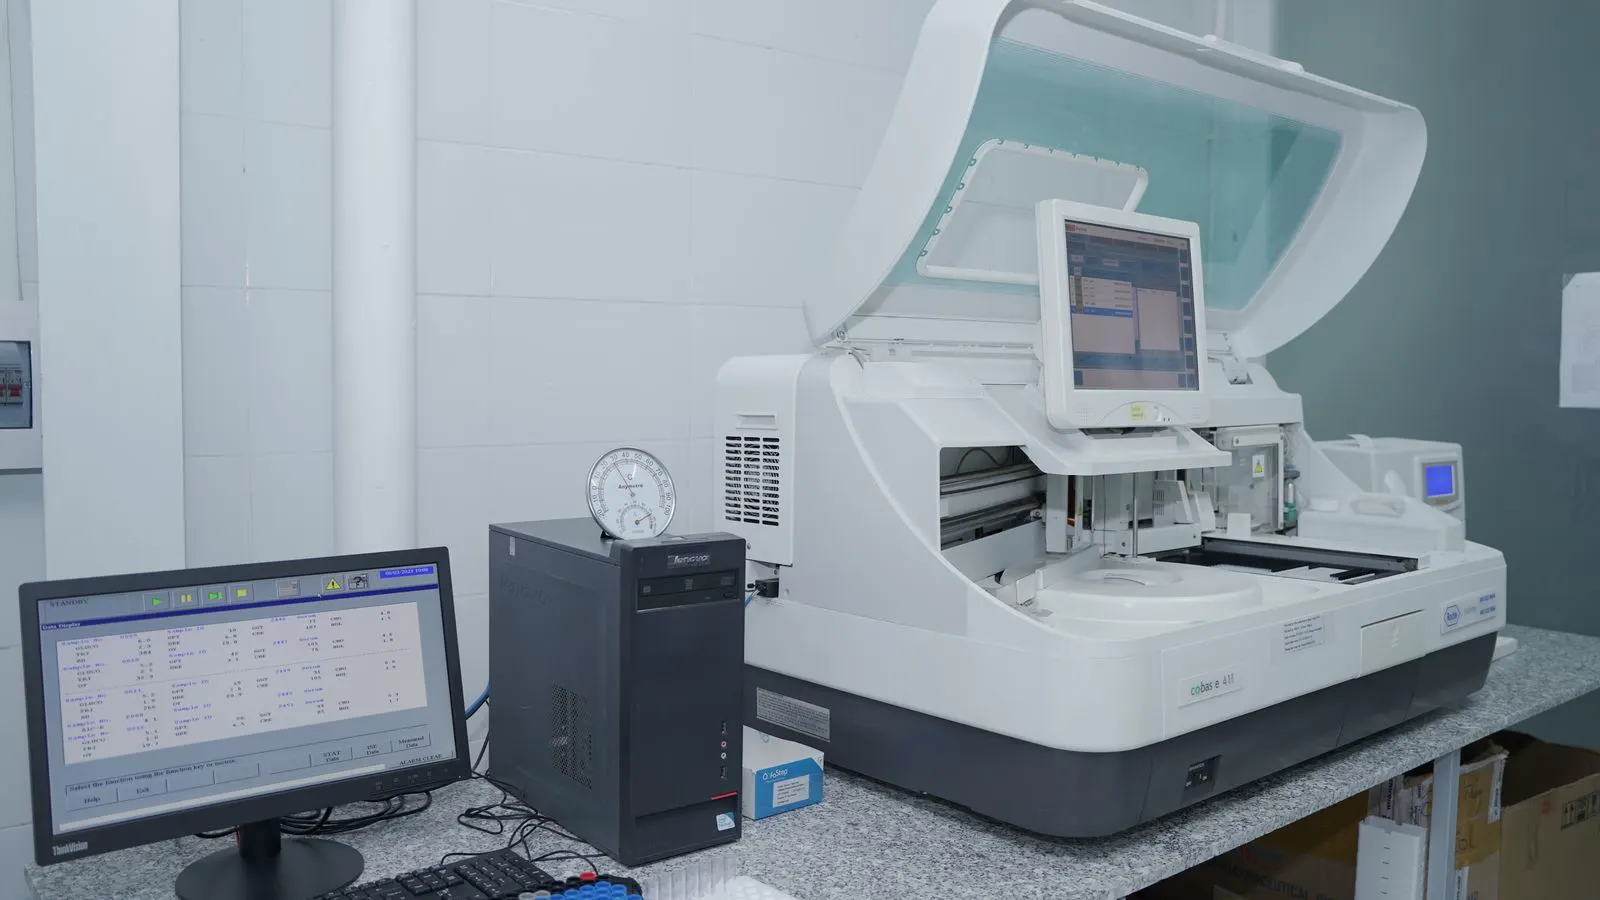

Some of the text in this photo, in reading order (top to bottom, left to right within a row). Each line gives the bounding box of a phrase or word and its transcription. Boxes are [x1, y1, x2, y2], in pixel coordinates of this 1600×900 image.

[1190, 680, 1213, 696] cobas
[1215, 680, 1220, 689] e
[70, 784, 90, 792] Select
[106, 776, 132, 786] function
[84, 796, 101, 805] Help
[52, 841, 88, 856] ThinkVision
